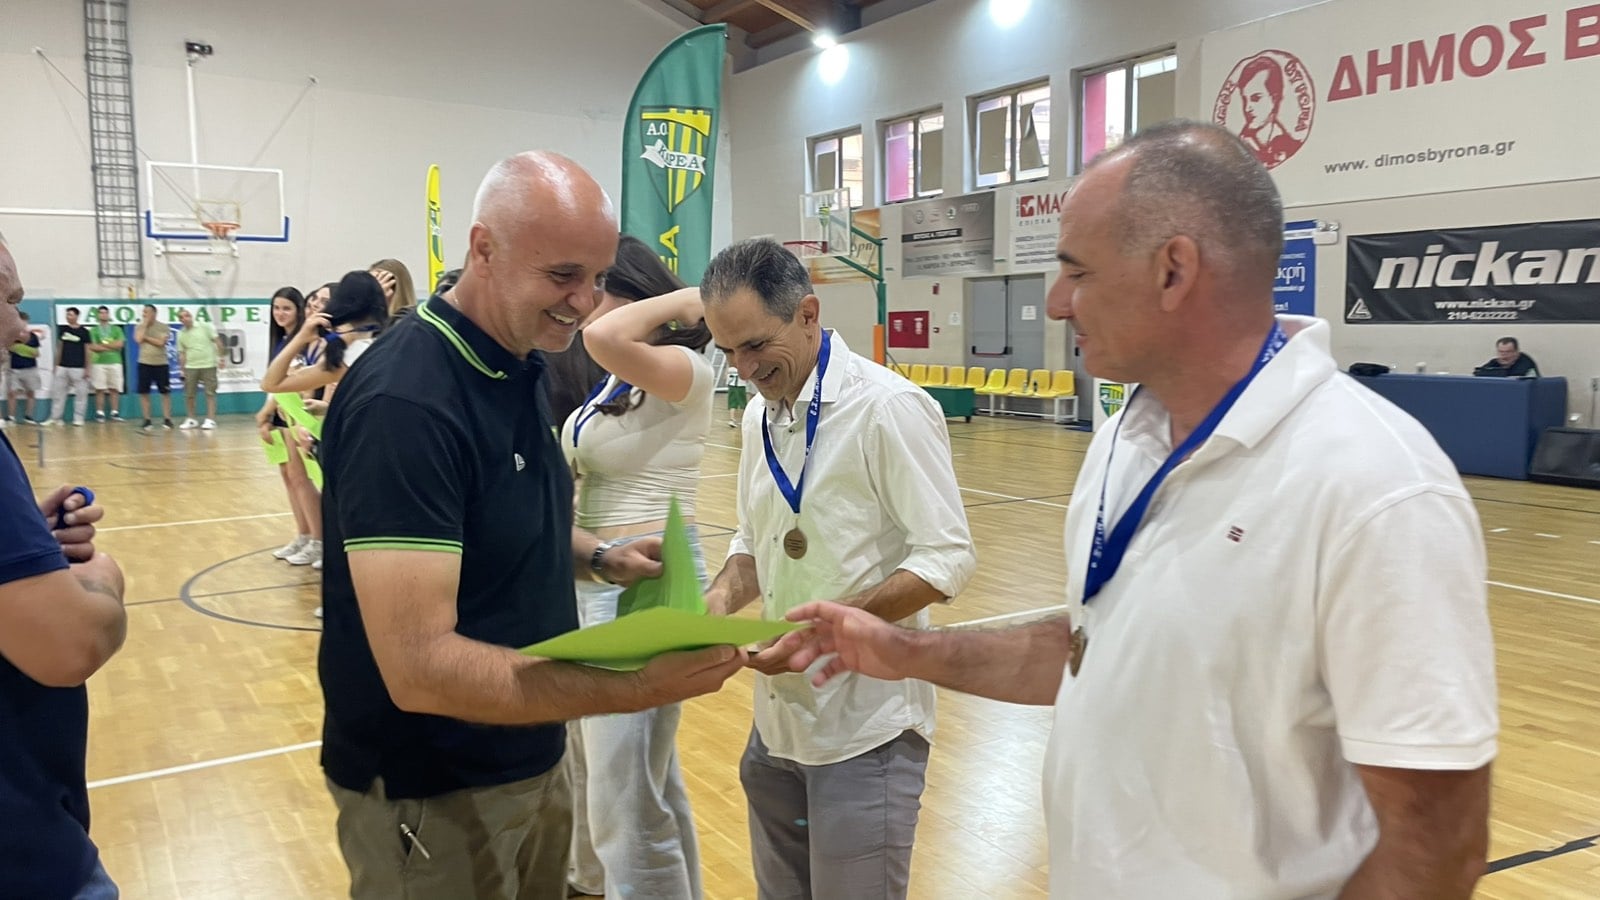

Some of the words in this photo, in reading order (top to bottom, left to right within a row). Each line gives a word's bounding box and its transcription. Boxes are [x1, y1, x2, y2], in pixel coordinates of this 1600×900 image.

[1326, 14, 1547, 102] ΔΗΜΟΣ
[1324, 159, 1369, 174] www.
[1374, 138, 1516, 169] dimosbyrona.gr
[1373, 241, 1600, 290] nickan
[1434, 298, 1536, 310] www.nickan.gr
